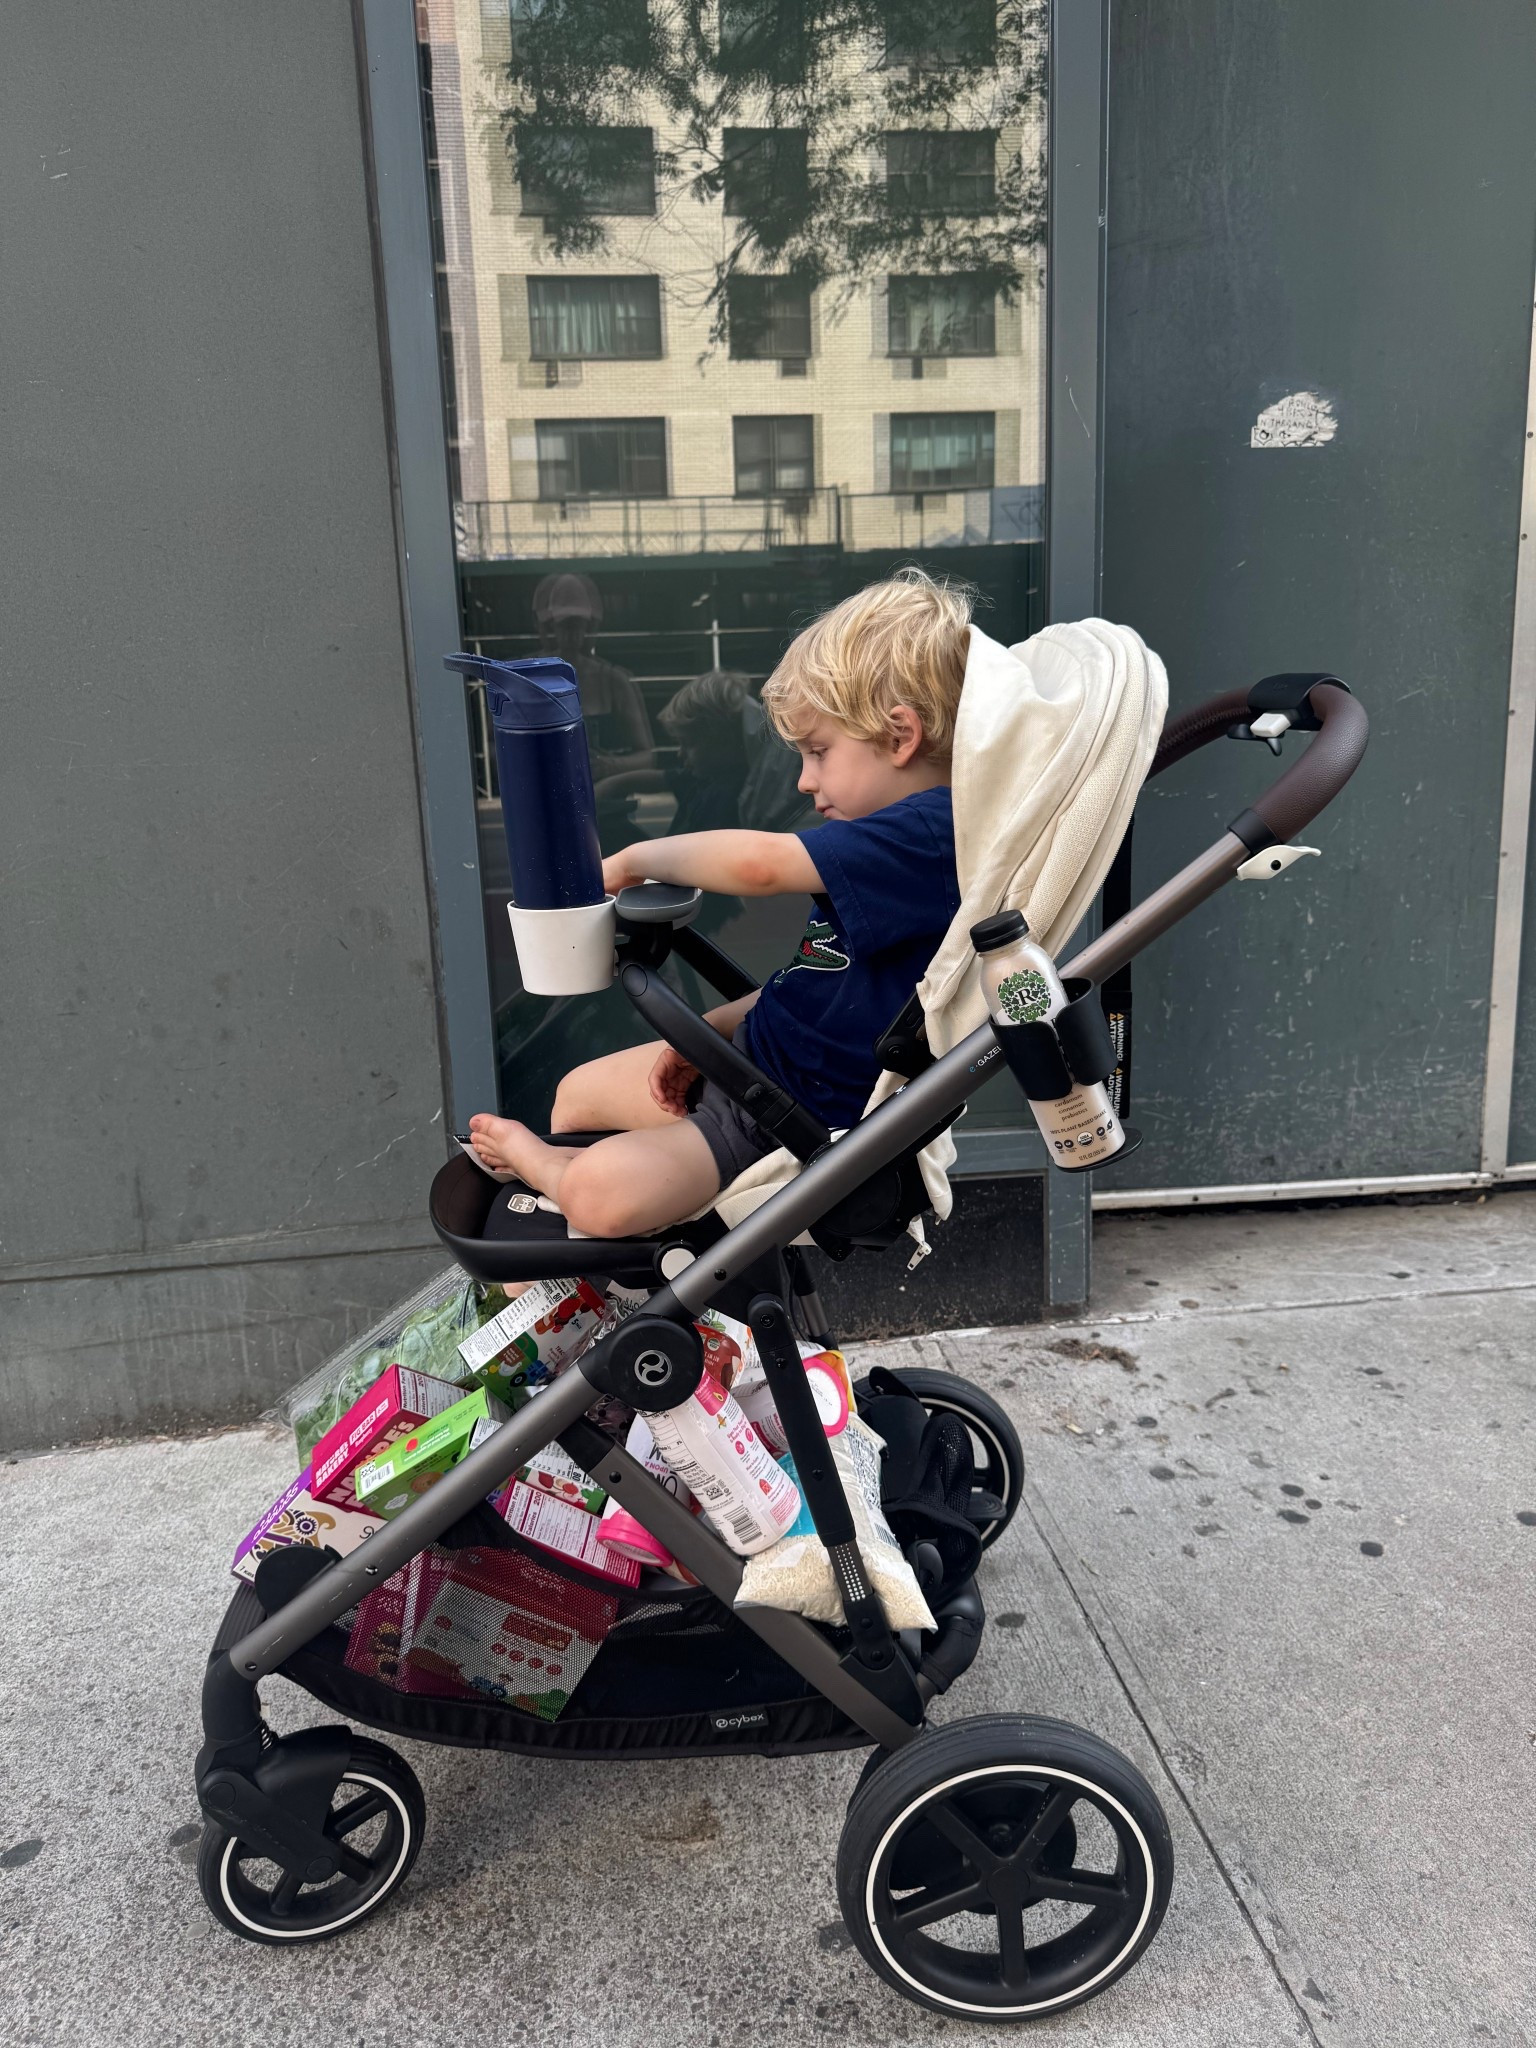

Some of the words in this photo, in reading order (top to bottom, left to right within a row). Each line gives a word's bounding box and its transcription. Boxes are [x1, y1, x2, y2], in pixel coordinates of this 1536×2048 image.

[1019, 988, 1035, 1007] R
[1055, 1094, 1083, 1108] cardamom
[1058, 1101, 1085, 1114] cinnamon
[1061, 1108, 1088, 1122] prebiotics
[1061, 1125, 1077, 1134] PLANT
[1078, 1119, 1094, 1128] BASED
[552, 1291, 563, 1302] 80
[570, 1317, 579, 1325] 5
[417, 1374, 425, 1388] 200
[351, 1430, 361, 1442] FIG
[361, 1414, 374, 1430] BAR
[355, 1427, 373, 1448] Raspberry
[316, 1447, 349, 1488] BAKERY
[650, 1462, 671, 1474] UPON
[506, 1500, 518, 1522] utrition
[513, 1485, 521, 1501] Facts
[526, 1511, 538, 1535] Calories
[533, 1491, 542, 1507] 200
[729, 1713, 764, 1728] cybex
